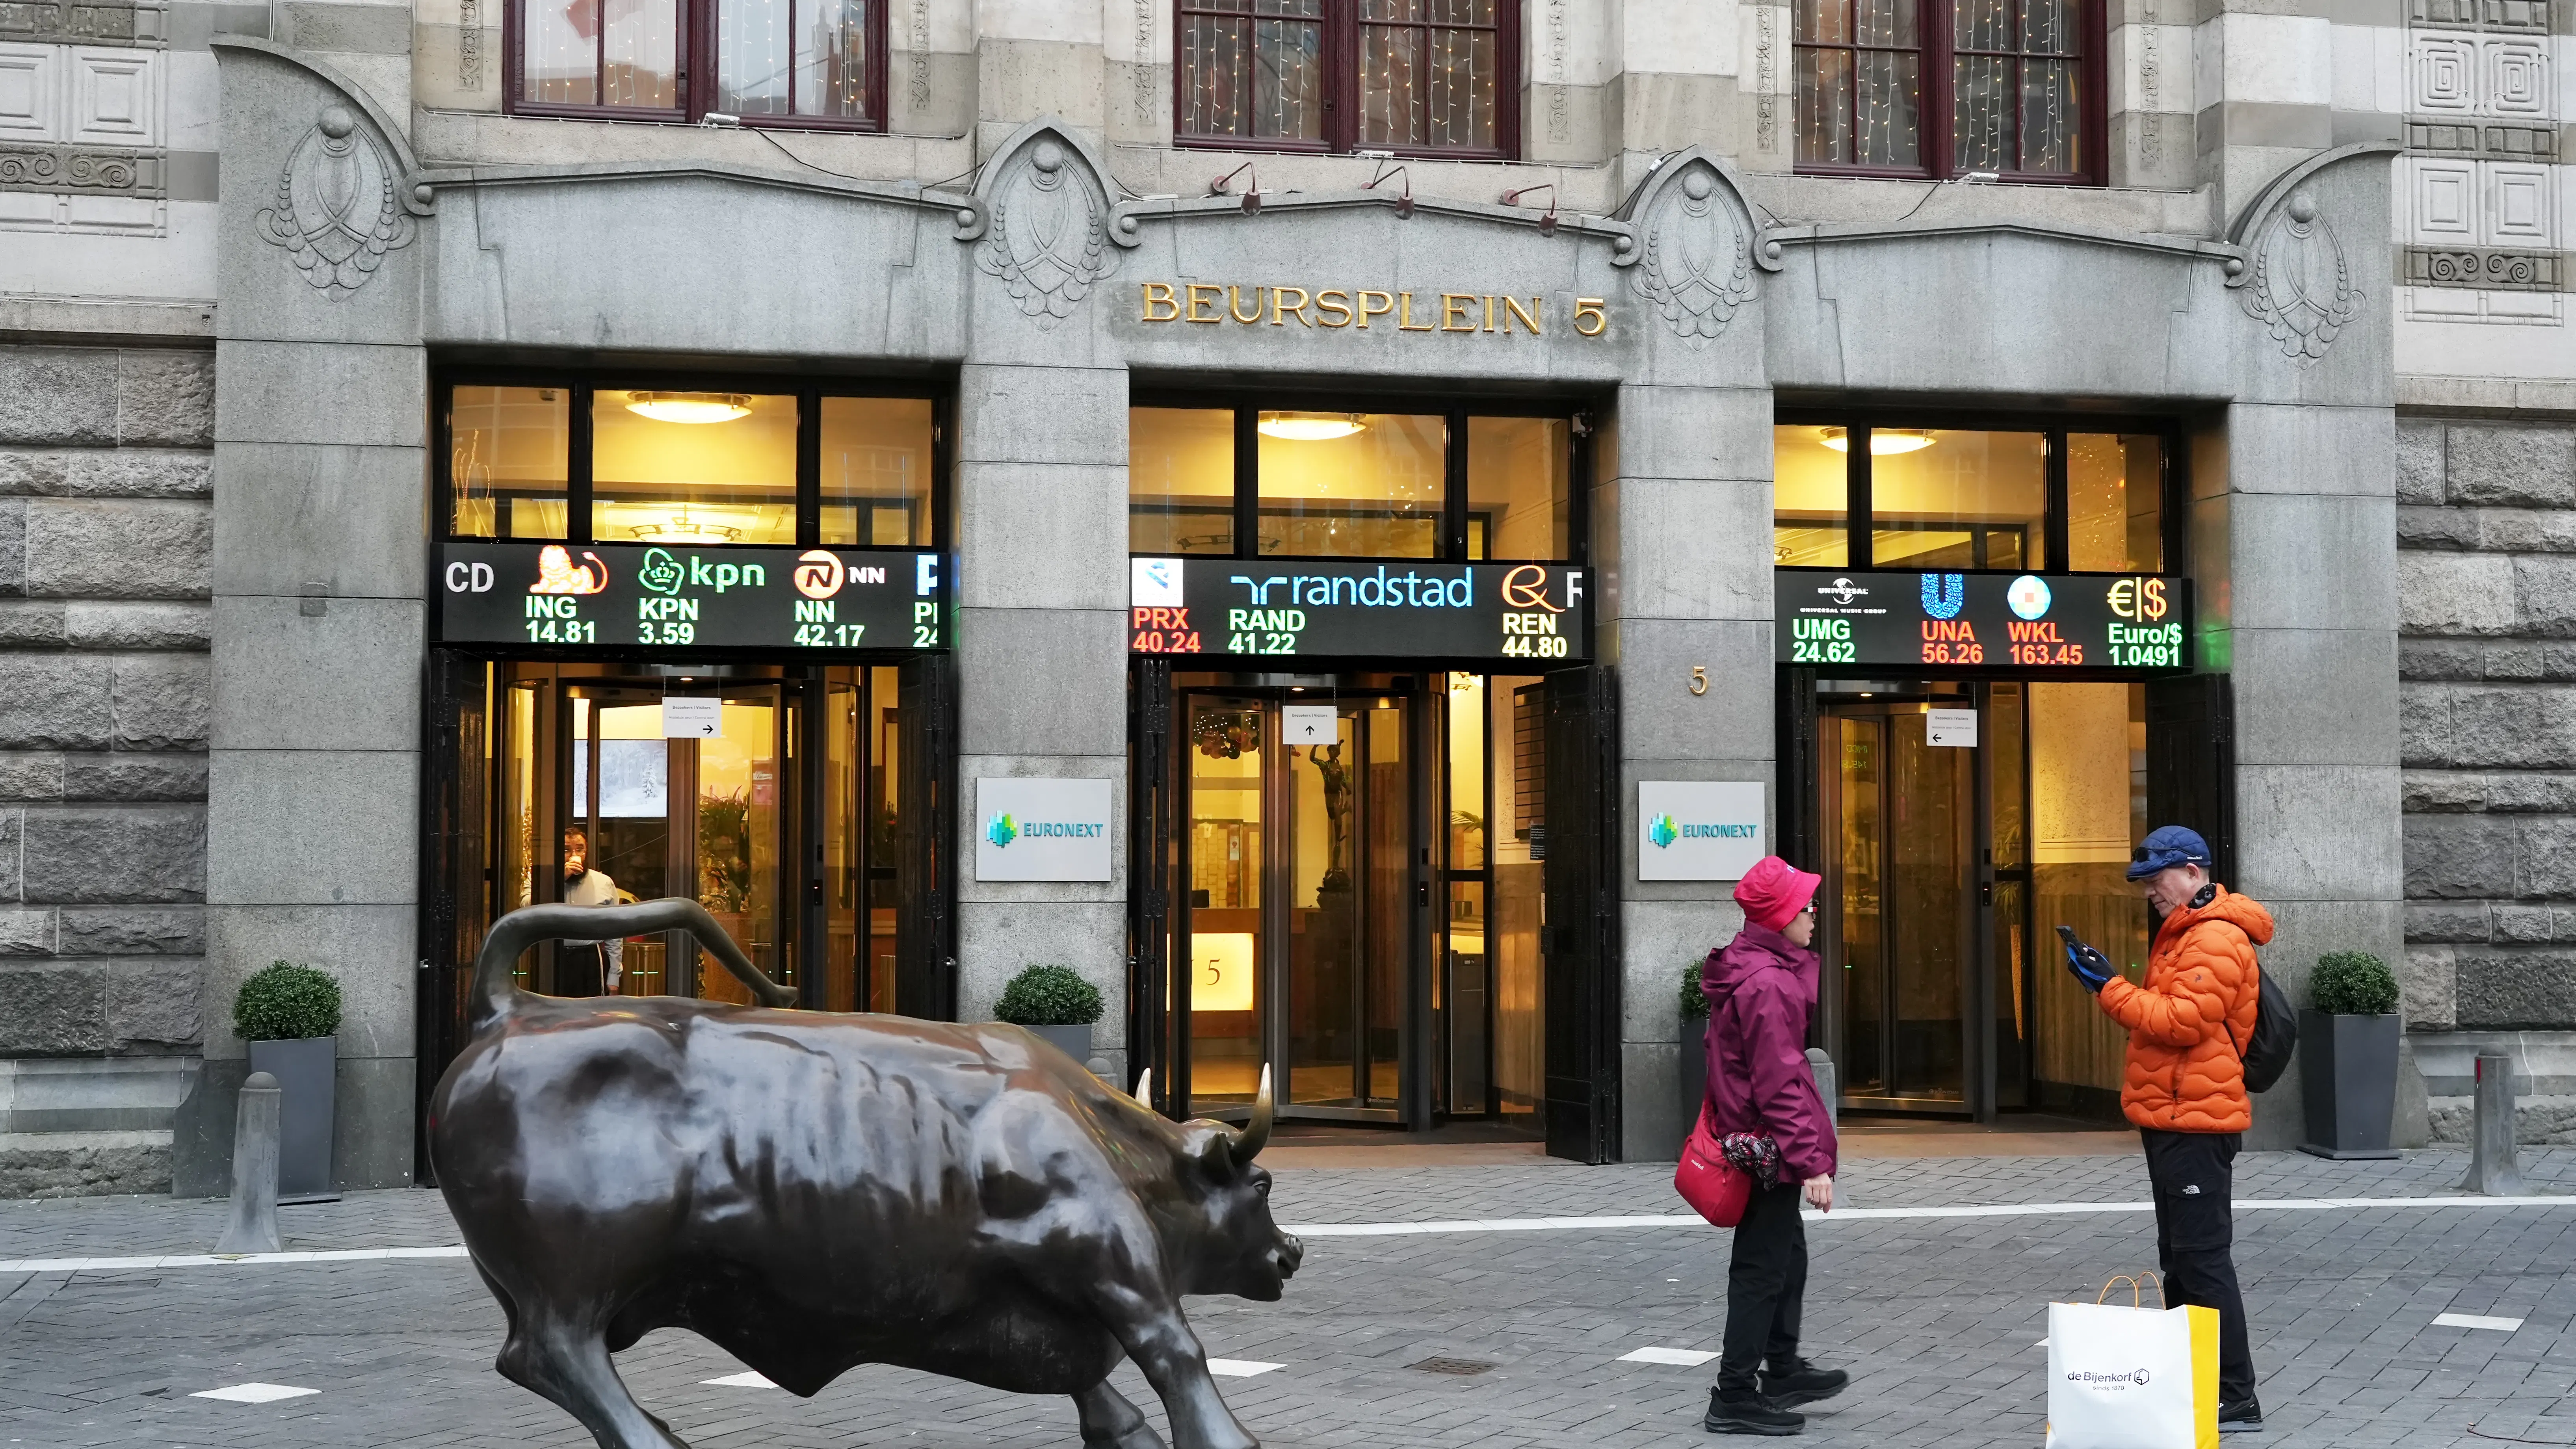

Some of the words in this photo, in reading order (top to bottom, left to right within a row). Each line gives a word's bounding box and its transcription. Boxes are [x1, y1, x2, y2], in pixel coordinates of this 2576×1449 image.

[1141, 283, 1541, 334] BEURSPLEIN
[1574, 297, 1605, 336] 5
[446, 562, 494, 593] CD
[690, 556, 765, 593] kpn
[848, 567, 885, 583] NN
[1293, 566, 1472, 607] randstad
[525, 596, 576, 618] ING
[639, 598, 698, 620] KPN
[795, 600, 835, 622] NN
[1134, 608, 1189, 630] PRX
[1229, 609, 1305, 631] RAND
[1502, 613, 1557, 635] REN
[1792, 619, 1850, 640] UMG
[526, 620, 595, 643] 14.81
[638, 622, 694, 645] 3.59
[793, 625, 865, 646] 42.17
[1922, 620, 1976, 641] UNA
[2007, 622, 2064, 643] WKL
[2108, 623, 2182, 646] Euro/$
[1132, 632, 1201, 653] 40.24
[1228, 633, 1295, 654] 41.22
[1502, 636, 1567, 657] 44.80
[1792, 641, 1855, 663] 24.62
[1921, 643, 1983, 664] 56.26
[2009, 645, 2083, 665] 163.45
[2108, 646, 2179, 666] 1.0491
[1689, 666, 1708, 695] 5
[1024, 823, 1103, 837] EURONEXT
[1683, 824, 1757, 837] EURONEXT
[1206, 959, 1220, 985] 5
[2068, 1371, 2082, 1380] de
[2083, 1372, 2132, 1383] Bijenkorf
